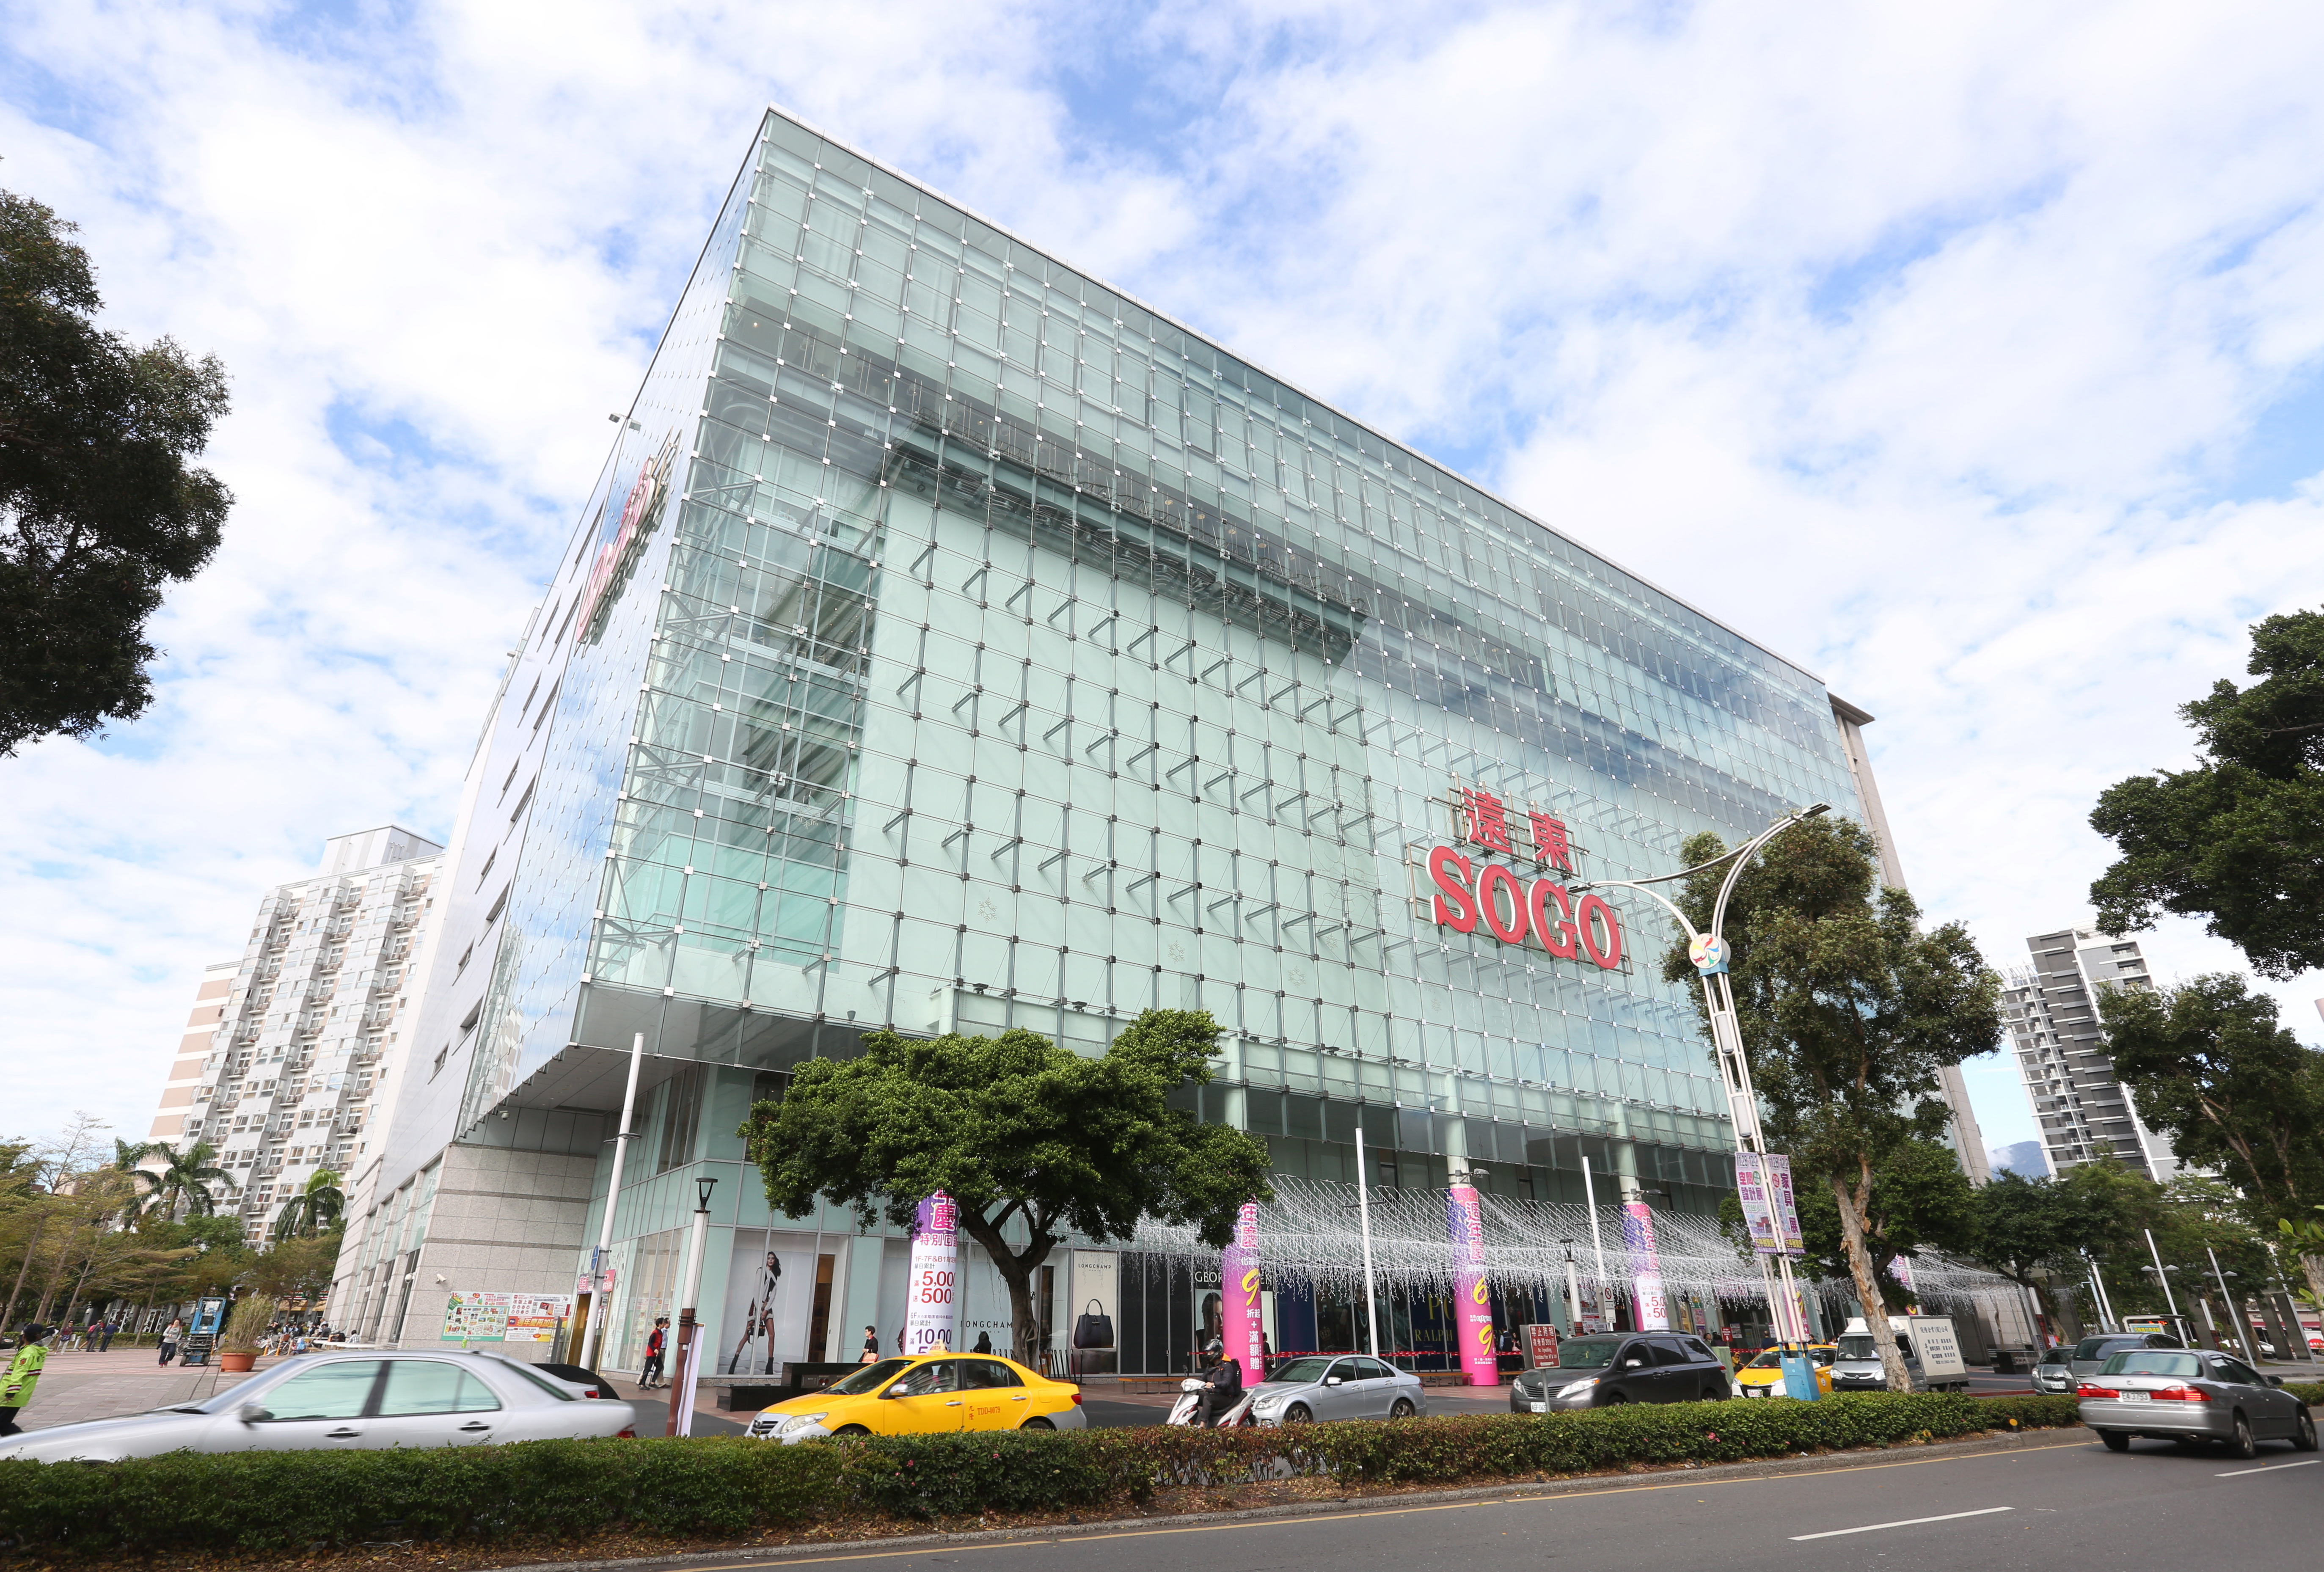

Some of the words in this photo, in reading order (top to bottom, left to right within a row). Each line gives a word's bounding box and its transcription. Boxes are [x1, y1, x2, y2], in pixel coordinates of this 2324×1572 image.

[1460, 786, 1574, 873] 遠東
[1425, 845, 1622, 969] SOGO
[1738, 1171, 1754, 1185] 空間
[1741, 1187, 1764, 1201] 設計展
[922, 1271, 956, 1288] 5,00
[921, 1288, 952, 1304] 500
[1246, 1308, 1261, 1319] 折起
[1415, 1329, 1453, 1341] RALPH
[1531, 1326, 1554, 1337] 禁止跨越
[1249, 1330, 1260, 1370] 滿額贈
